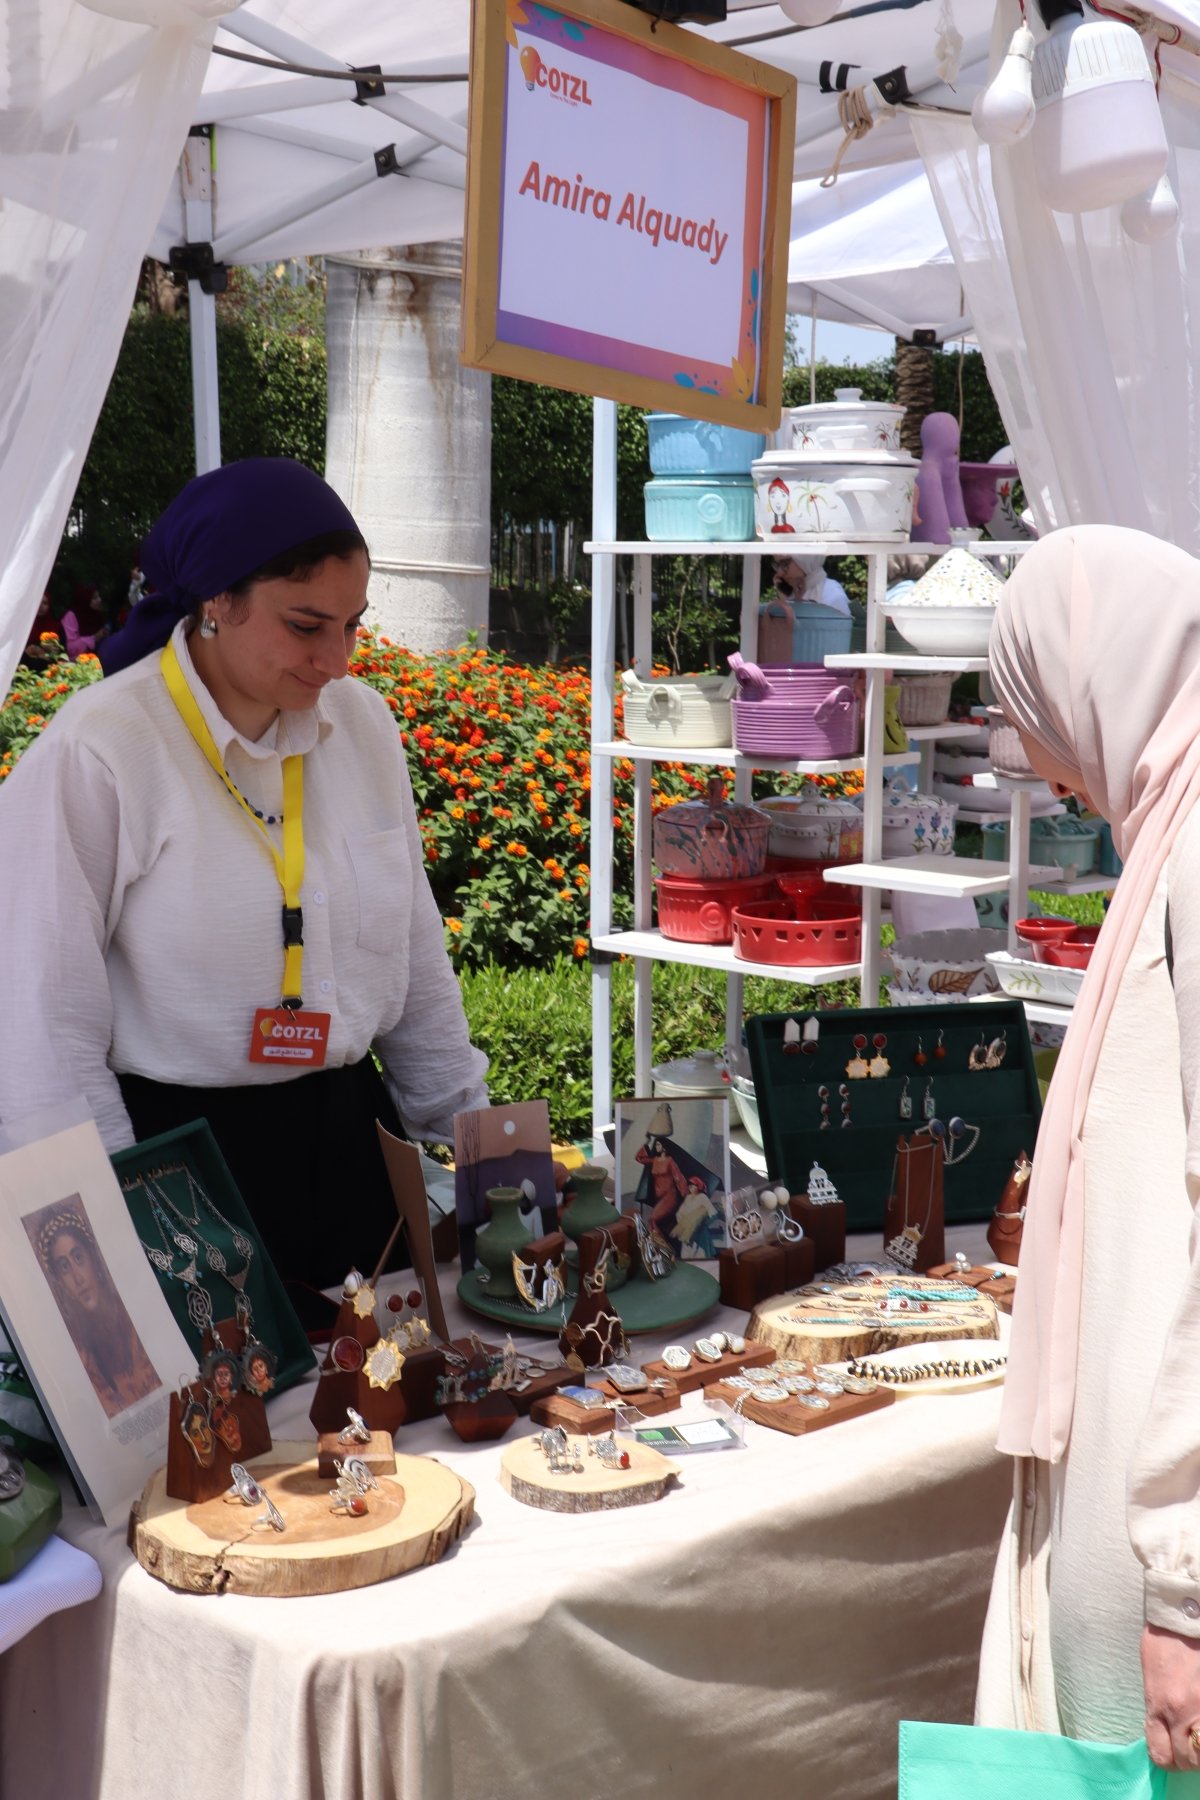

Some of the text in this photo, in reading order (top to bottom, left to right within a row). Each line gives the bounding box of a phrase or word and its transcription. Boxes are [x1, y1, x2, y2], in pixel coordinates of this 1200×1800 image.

[535, 63, 592, 105] COTZL
[518, 161, 728, 265] Amira Alquady
[271, 1025, 323, 1040] COTZL
